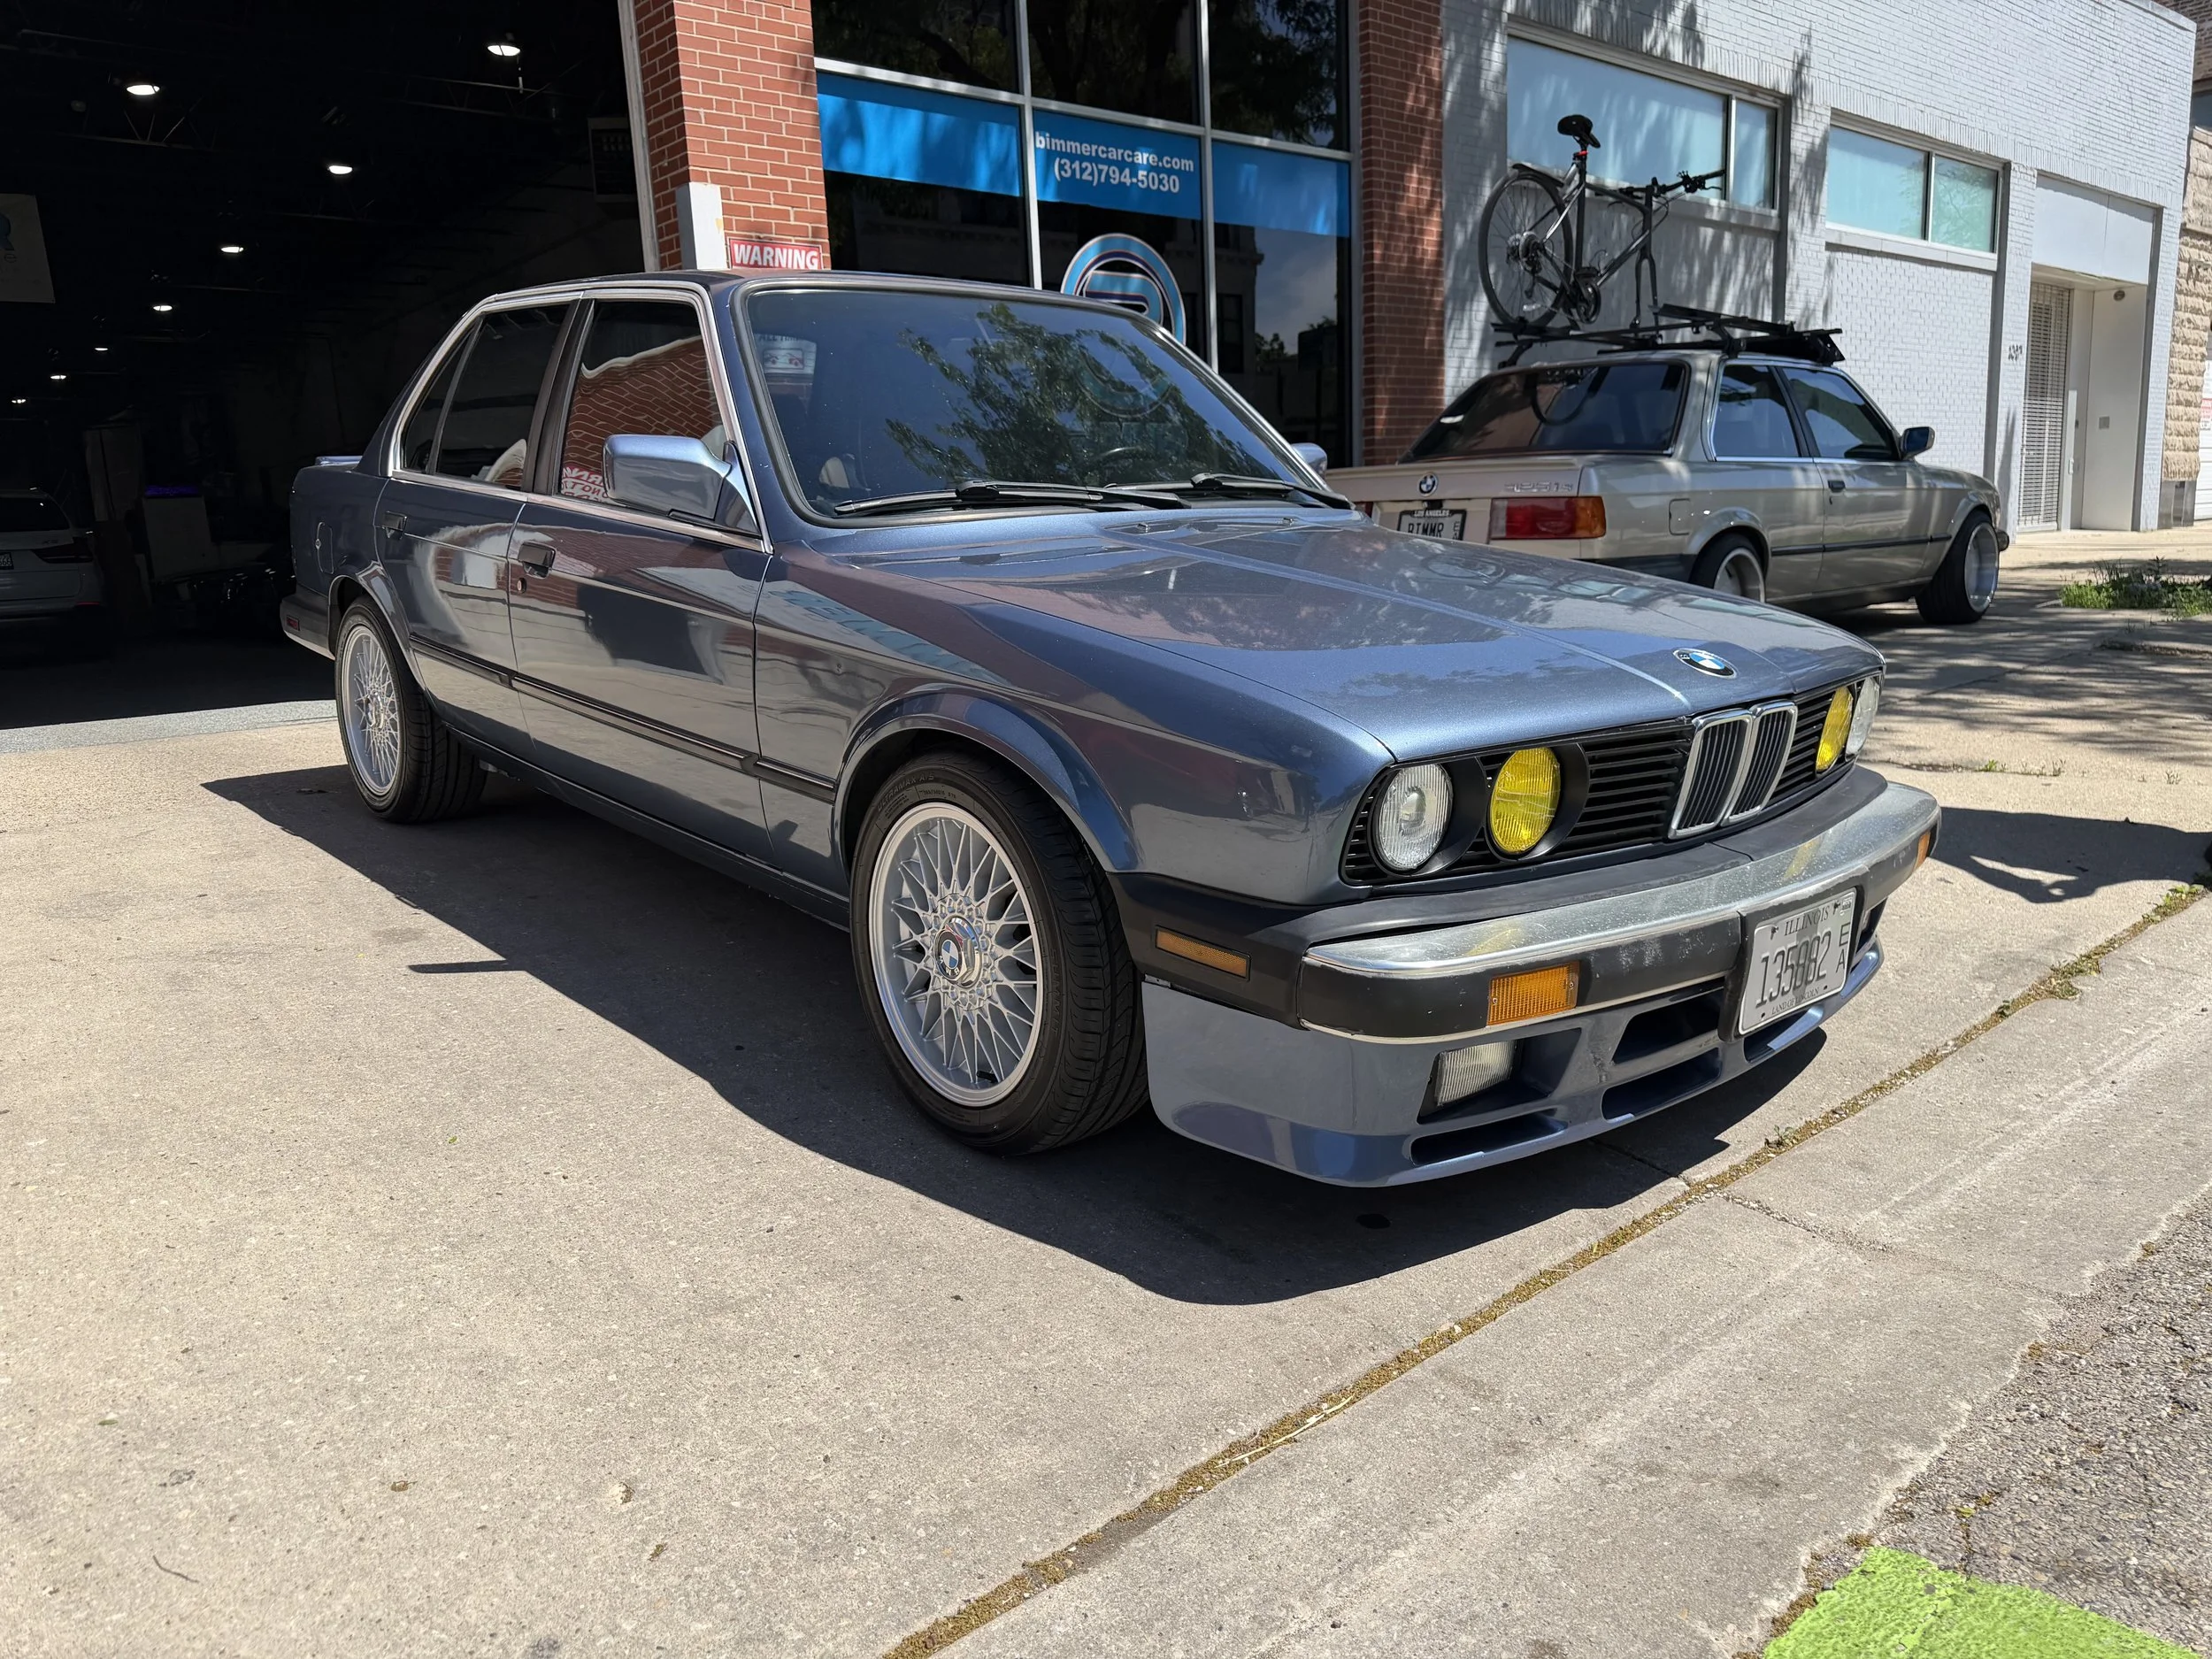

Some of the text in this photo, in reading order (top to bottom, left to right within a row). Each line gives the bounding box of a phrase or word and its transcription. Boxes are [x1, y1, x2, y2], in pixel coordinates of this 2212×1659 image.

[1035, 132, 1194, 172] bimmercarcare.com
[1054, 157, 1179, 193] (312)794-5030
[733, 243, 818, 270] WARNING
[1784, 905, 1830, 936] ILLINOIS
[1771, 1000, 1786, 1015] LAND
[1795, 986, 1819, 1004] LINCOLN
